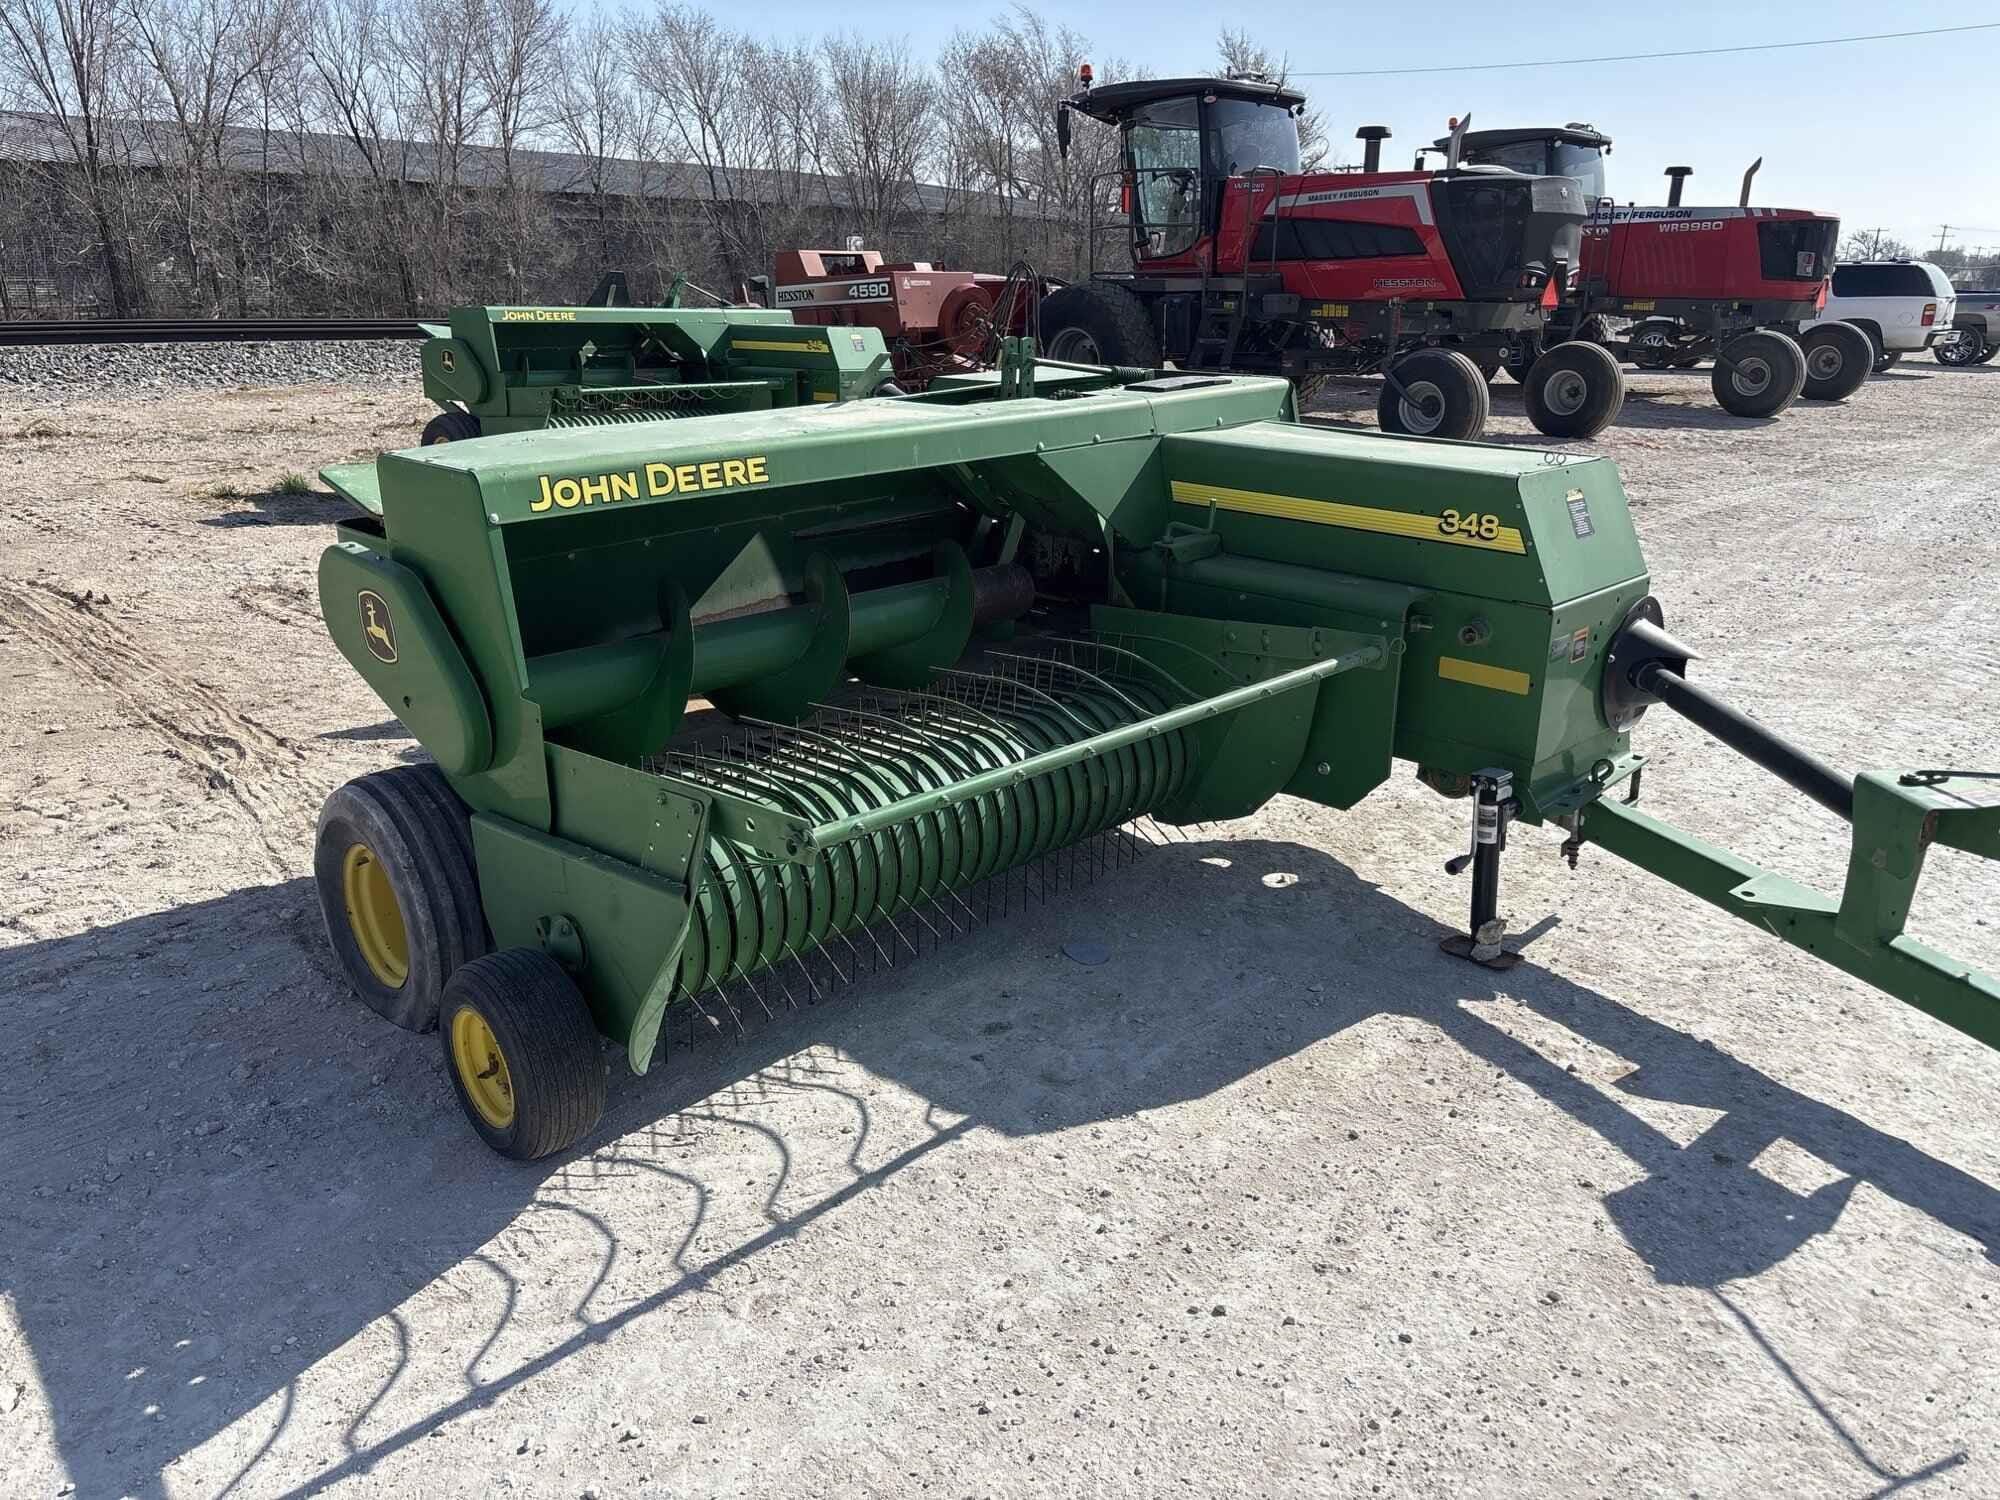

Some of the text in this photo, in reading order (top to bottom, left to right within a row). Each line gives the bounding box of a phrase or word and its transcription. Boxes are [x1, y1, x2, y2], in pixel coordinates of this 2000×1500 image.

[1308, 189, 1380, 202] MASSEY FERGUSON
[1632, 210, 1693, 219] FERGUSON
[1658, 221, 1724, 233] WR9980
[1373, 278, 1437, 289] HESSTON
[777, 283, 890, 302] HESSTON 4590
[502, 310, 577, 321] JOHN DEERE
[529, 456, 770, 513] JOHN DEERE
[1438, 508, 1499, 540] 348
